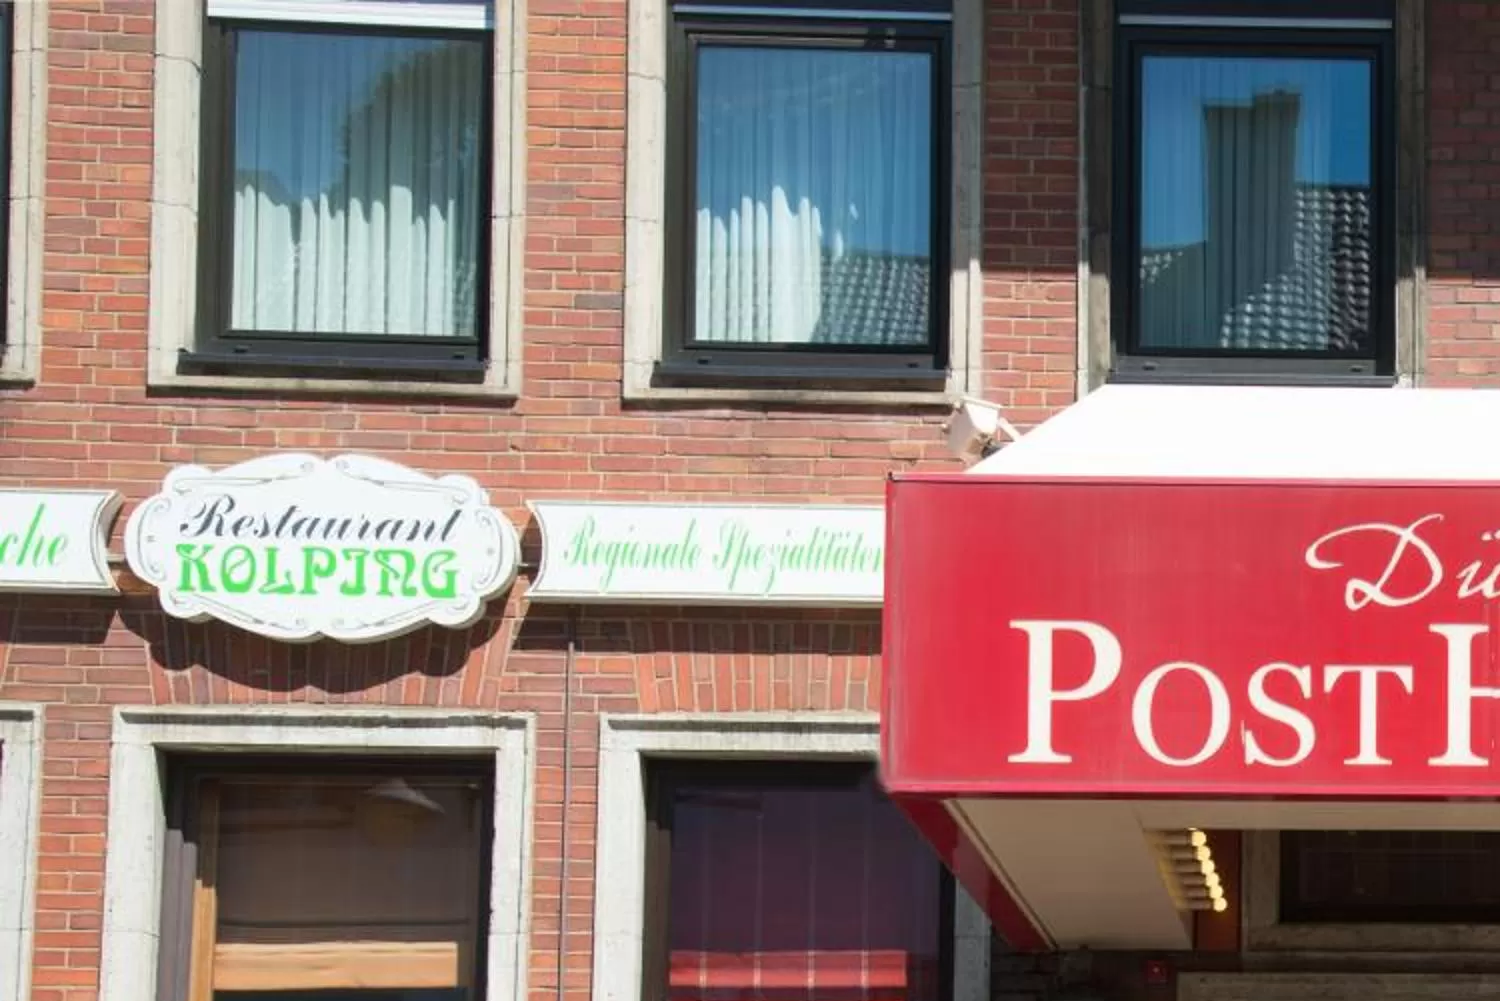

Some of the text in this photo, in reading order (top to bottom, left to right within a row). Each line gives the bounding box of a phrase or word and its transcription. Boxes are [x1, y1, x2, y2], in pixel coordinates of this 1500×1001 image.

[179, 493, 463, 542] Restaurant
[174, 543, 459, 599] KOLPING
[563, 512, 702, 592] Regionale
